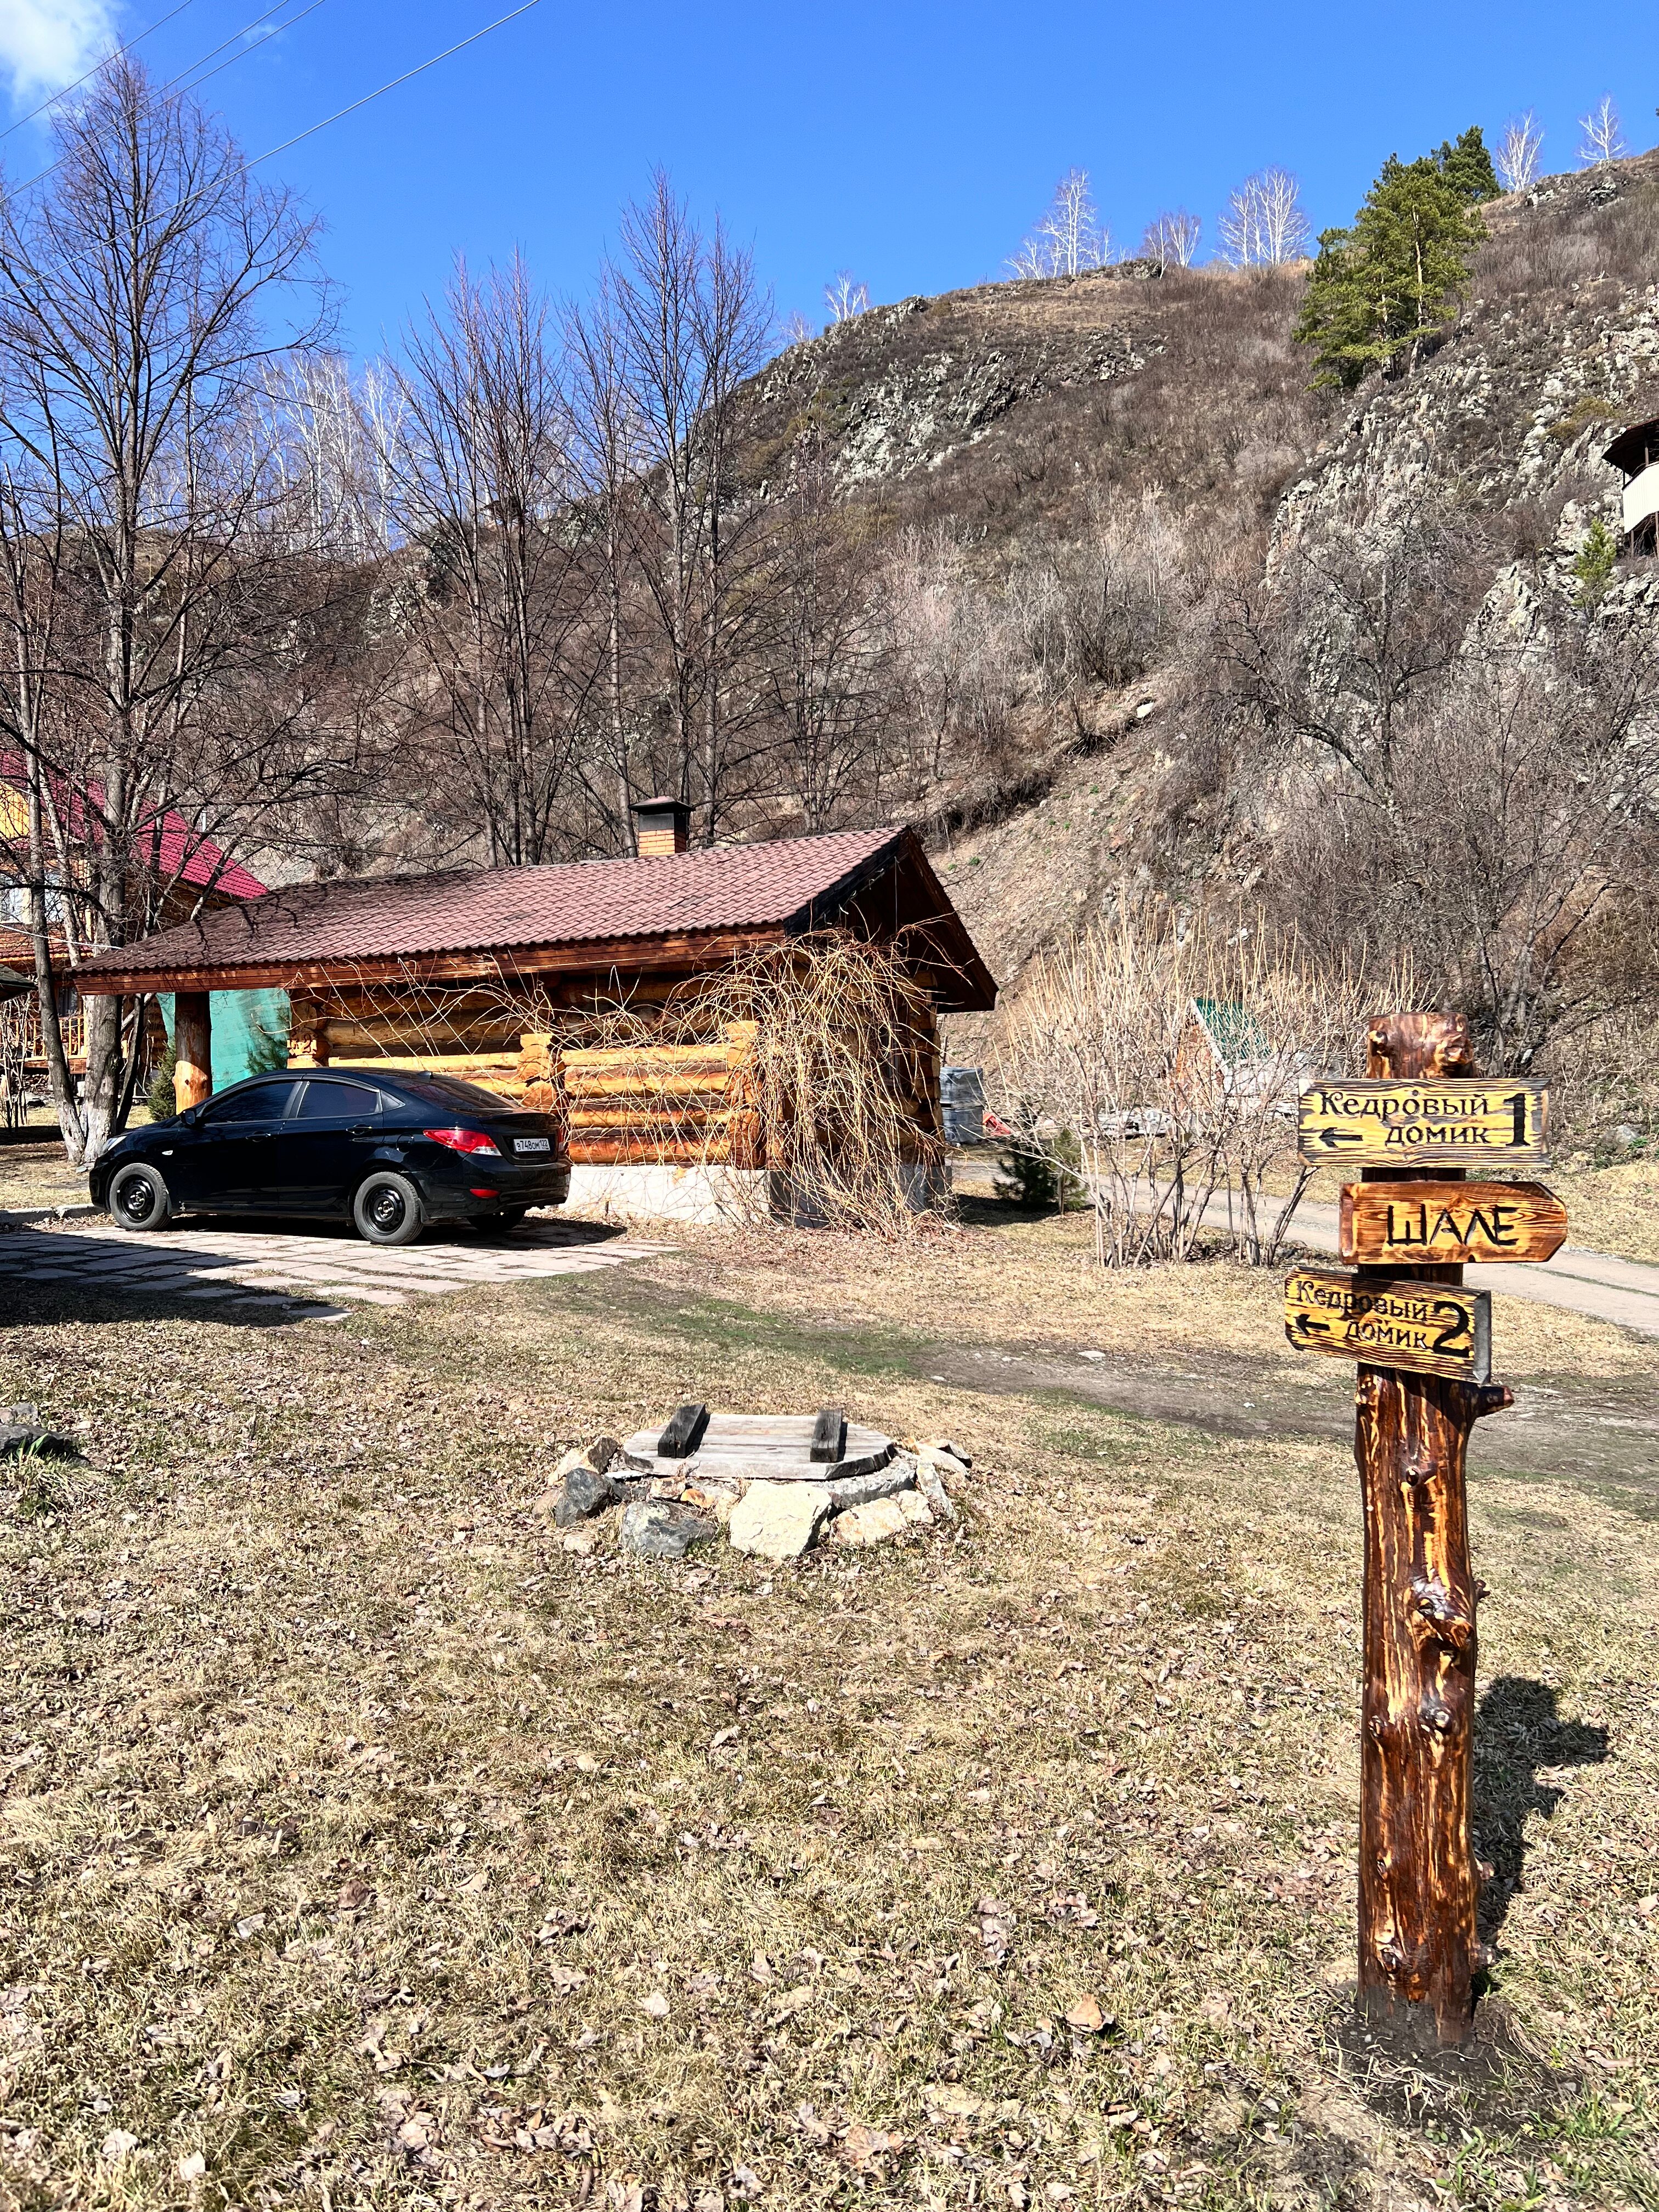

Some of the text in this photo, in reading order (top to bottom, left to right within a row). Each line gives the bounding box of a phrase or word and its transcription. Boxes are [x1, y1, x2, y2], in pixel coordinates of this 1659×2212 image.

[1319, 1092, 1489, 1122] Кедровый
[1384, 1092, 1531, 1147] домик 1
[1386, 1204, 1520, 1246] ШАЛЕ
[1296, 1280, 1431, 1321] Кедровый
[1345, 1300, 1470, 1358] домик 2
